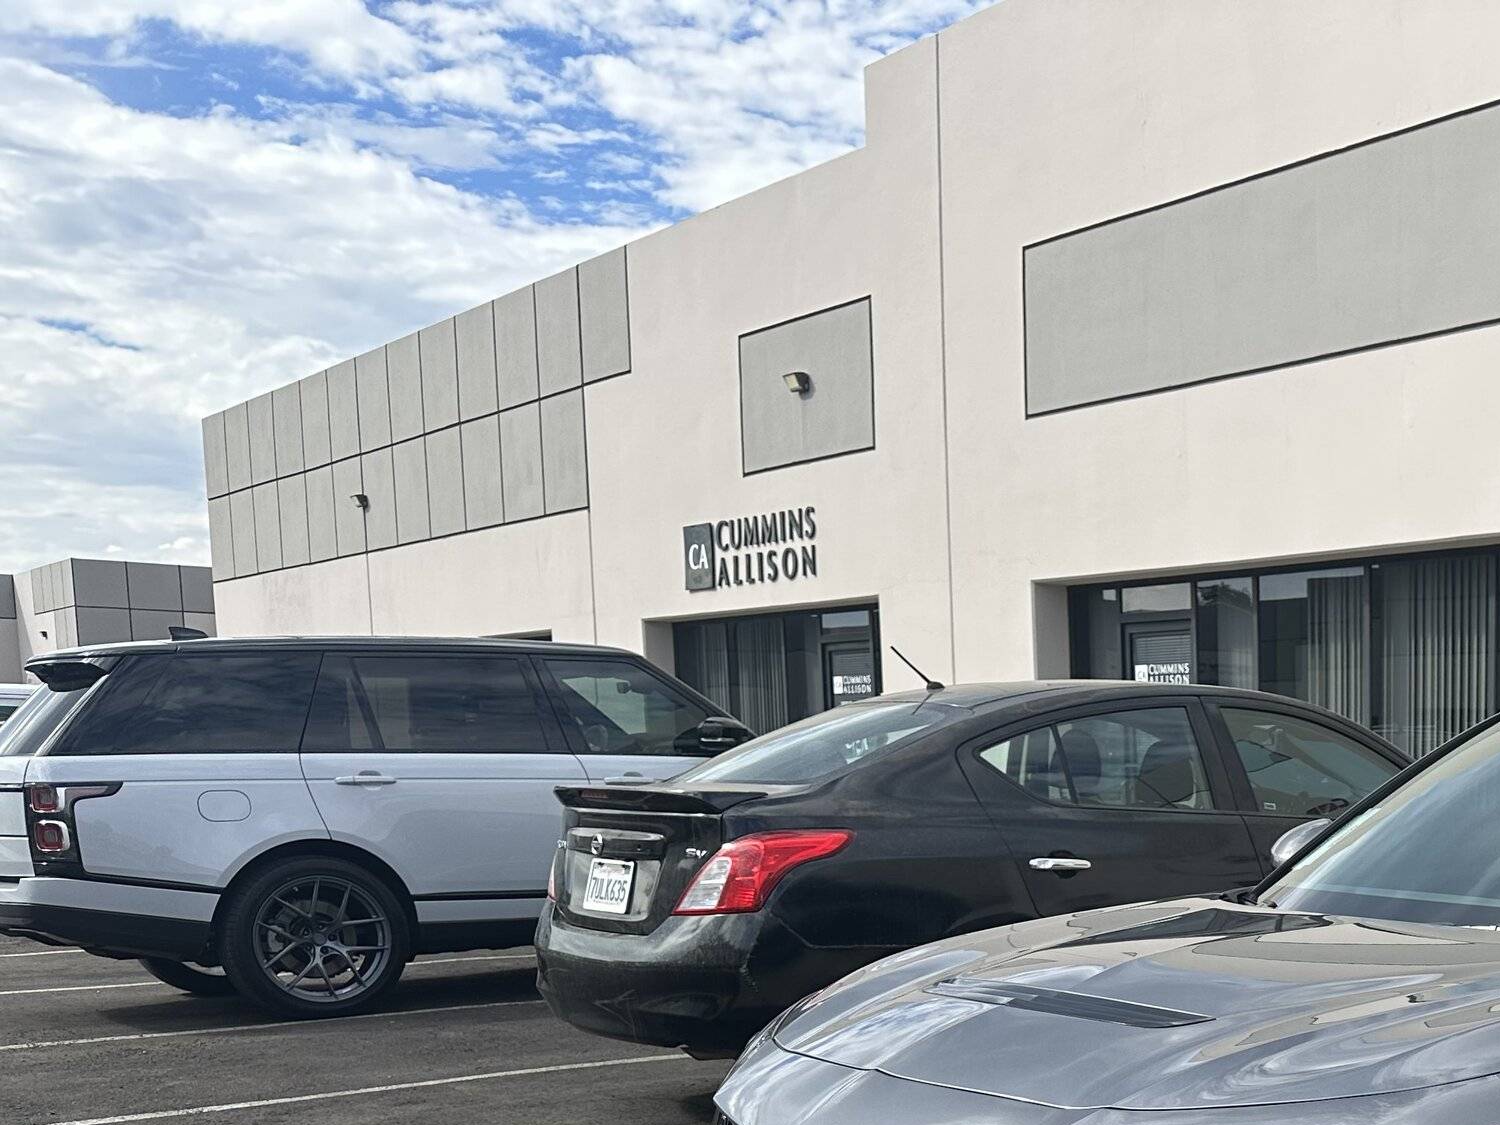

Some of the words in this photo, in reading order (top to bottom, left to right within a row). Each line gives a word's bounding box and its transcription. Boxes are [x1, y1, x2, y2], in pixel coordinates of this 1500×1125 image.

[716, 506, 817, 552] CUMMINS
[688, 543, 709, 570] CA
[718, 545, 817, 588] ALLISON
[590, 877, 627, 902] 7ULK635
